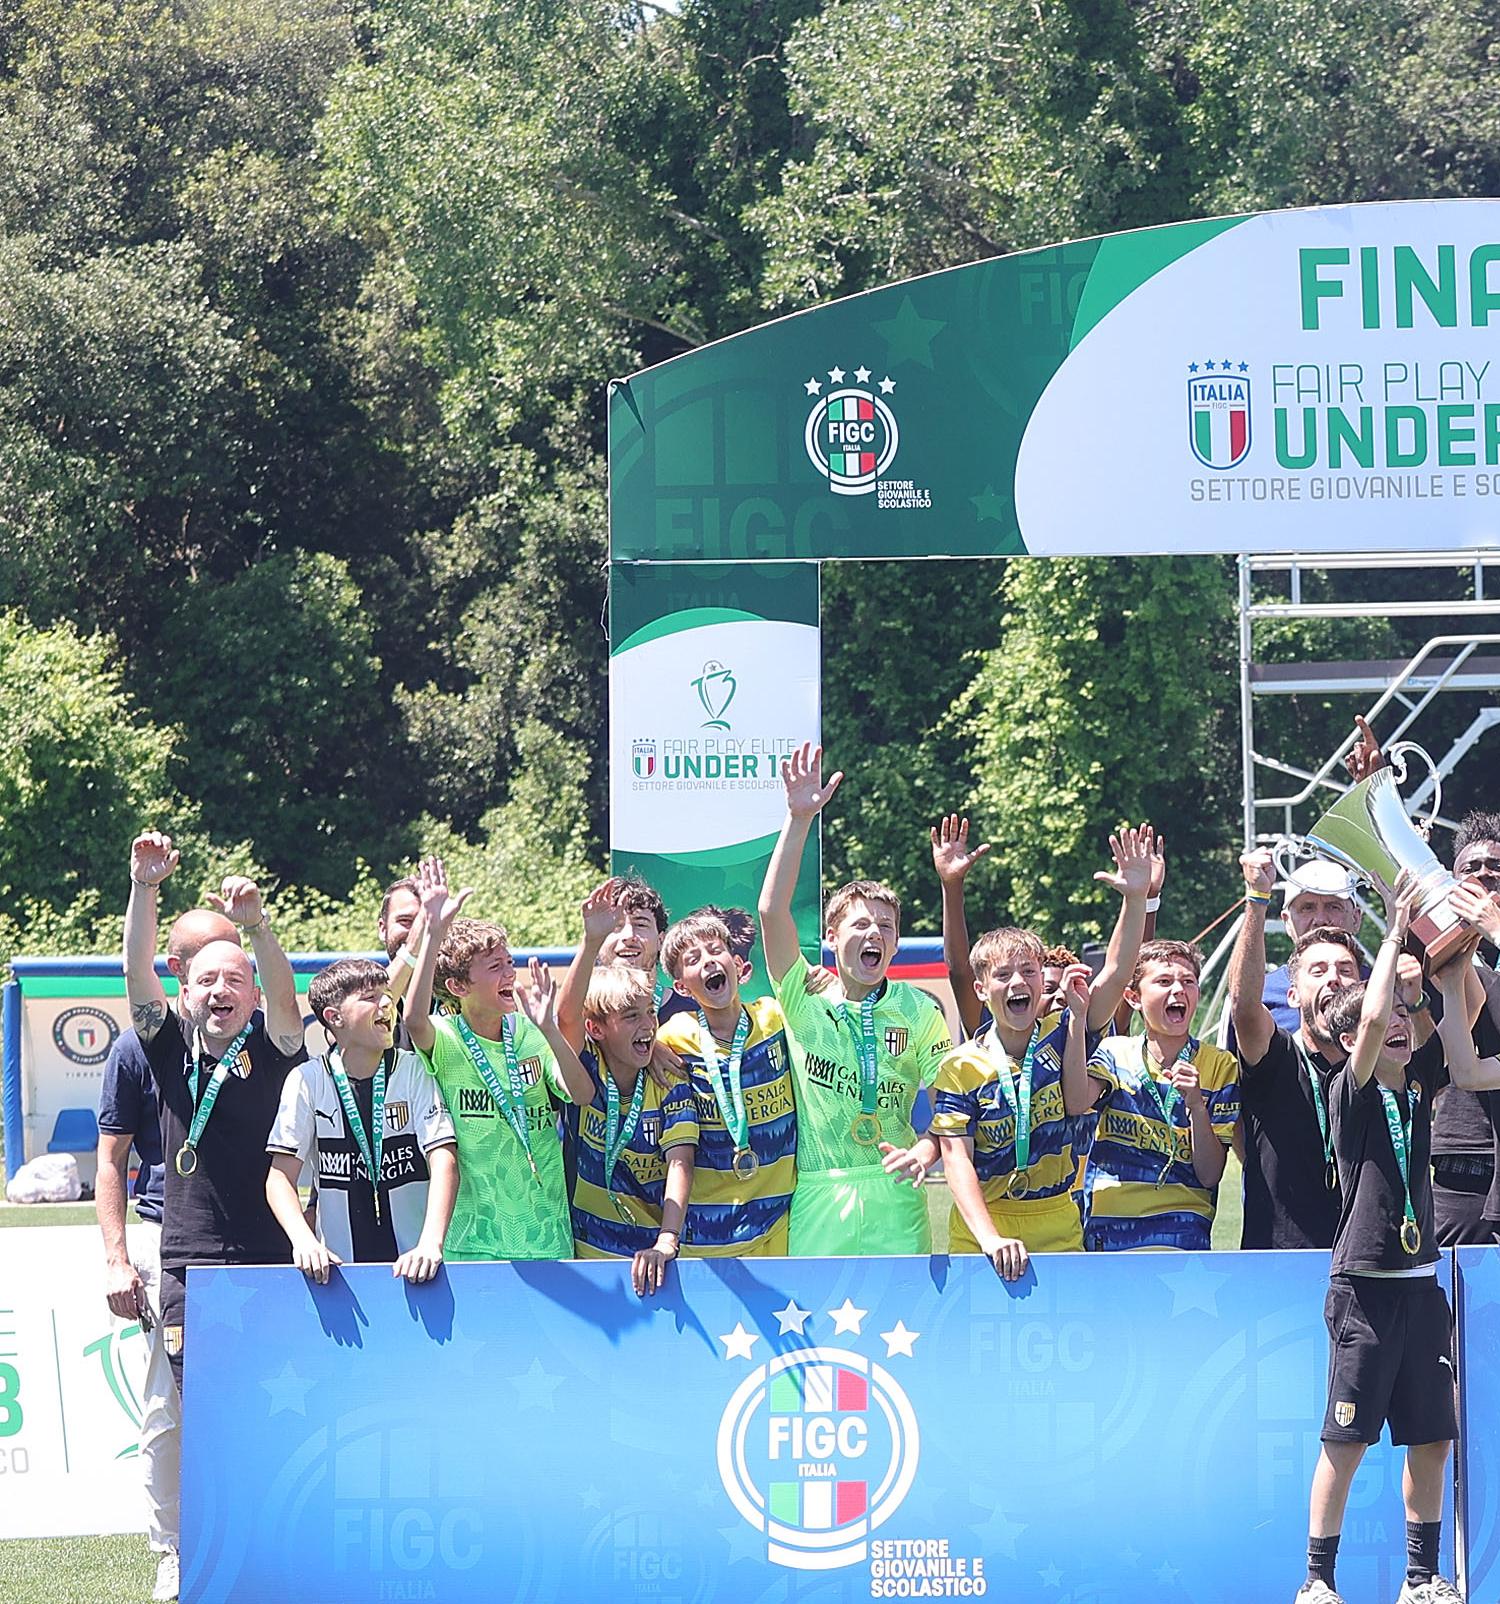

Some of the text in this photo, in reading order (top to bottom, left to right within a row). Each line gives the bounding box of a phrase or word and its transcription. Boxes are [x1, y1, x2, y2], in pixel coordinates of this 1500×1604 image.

[1194, 384, 1244, 401] ITALIA
[1272, 363, 1363, 404] FAIR
[1386, 360, 1491, 402] PLAY
[828, 422, 875, 444] FIGC
[843, 444, 861, 452] ITALIA
[877, 480, 914, 490] SETTORE
[877, 489, 930, 499] GIOVANILE E
[1190, 476, 1301, 502] SETTORE
[1309, 473, 1444, 500] GIOVANILE
[1453, 473, 1467, 497] E
[878, 499, 932, 508] SCOLASTICO
[663, 738, 796, 754] FAIR PLAY ELITE
[664, 755, 758, 779] UNDER
[632, 781, 674, 791] SETTORE
[677, 781, 727, 790] GIOVANILE
[738, 779, 783, 790] SCOLASTI
[224, 1036, 246, 1061] 2026
[466, 1037, 507, 1105] FINALE 2026
[503, 1028, 523, 1097] FINALE 2026
[757, 1083, 786, 1101] SALES
[373, 1103, 384, 1134] 2026
[624, 1103, 640, 1133] 2026
[750, 1097, 791, 1120] ERGIA
[1389, 1117, 1405, 1150] 2026
[382, 1146, 414, 1166] ALES
[969, 1320, 1095, 1373] FIGC
[768, 1416, 868, 1460] FIGC
[798, 1464, 837, 1477] ITALIA
[335, 1508, 484, 1571] FIGC
[871, 1539, 949, 1559] SETTORE
[613, 1550, 683, 1580] FIGC
[871, 1558, 983, 1579] GIOVANILE E
[871, 1577, 987, 1598] SCOLASTICO
